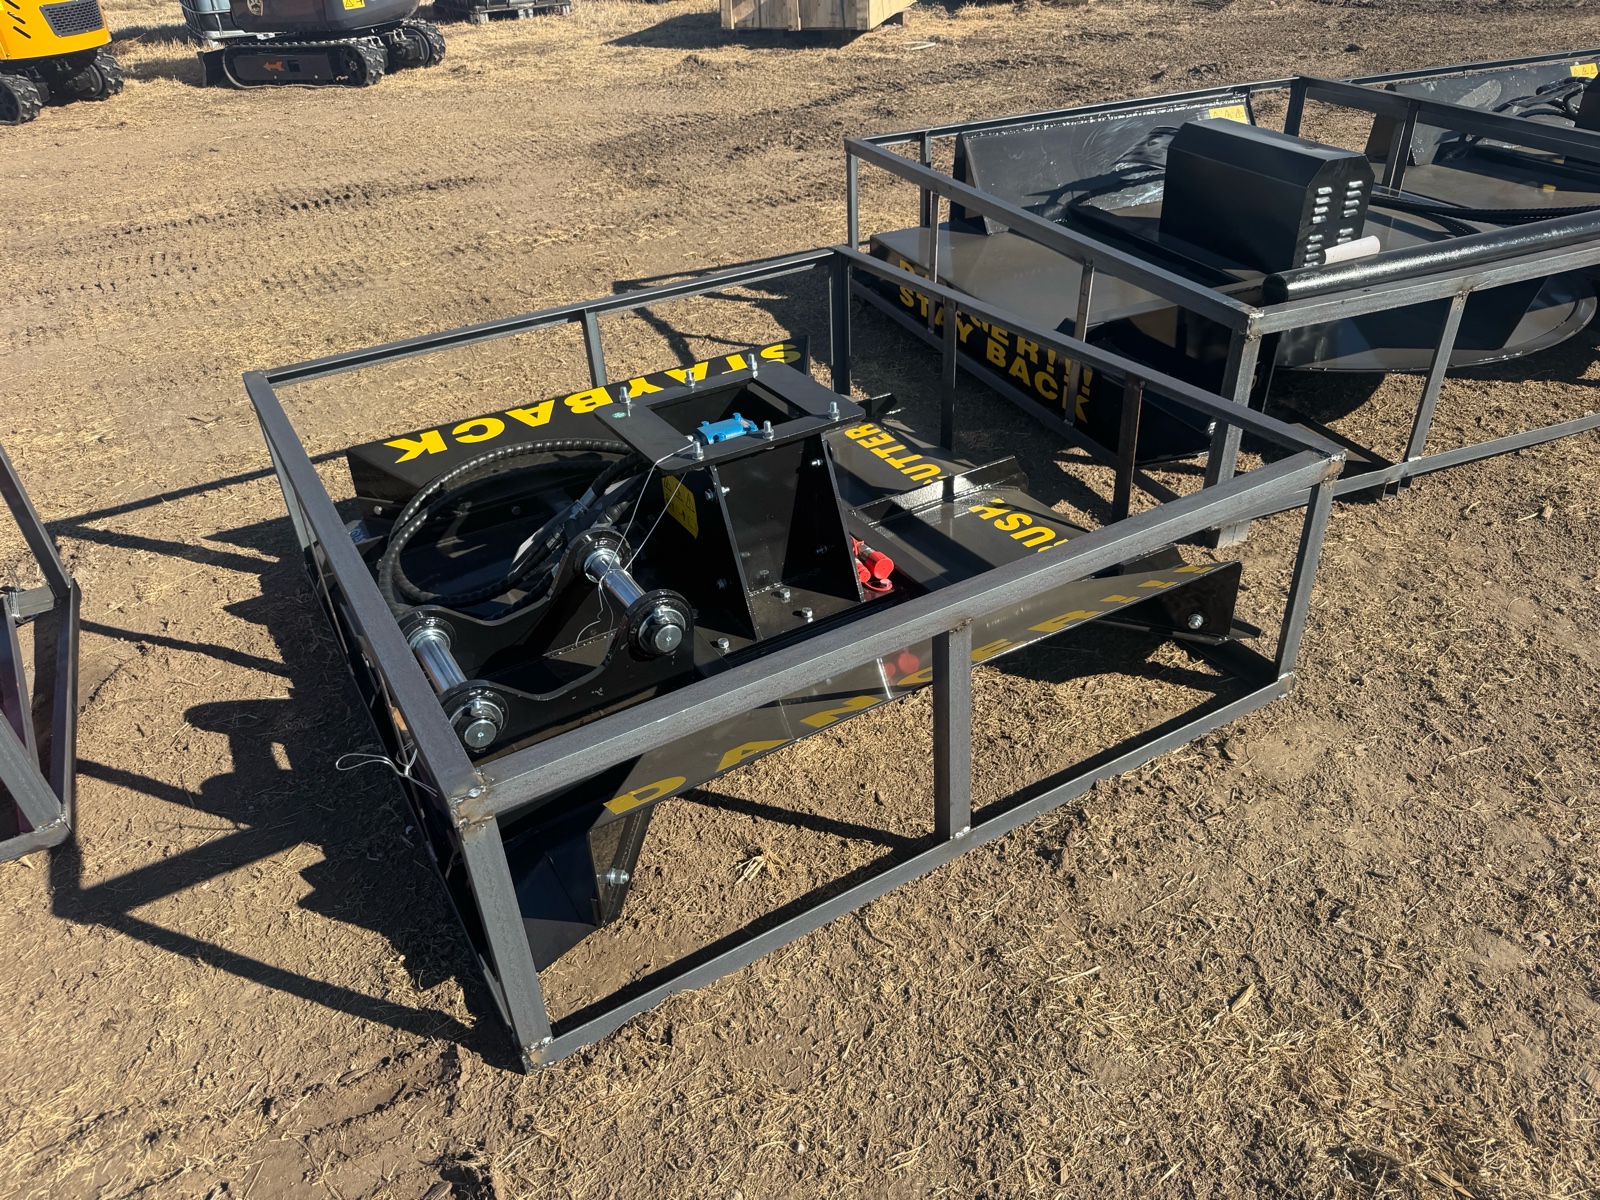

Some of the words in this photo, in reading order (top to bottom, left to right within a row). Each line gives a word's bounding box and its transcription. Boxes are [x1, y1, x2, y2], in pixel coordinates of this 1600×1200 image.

[986, 337, 1091, 424] BACK
[844, 423, 948, 485] UTTER
[968, 498, 1069, 553] USH
